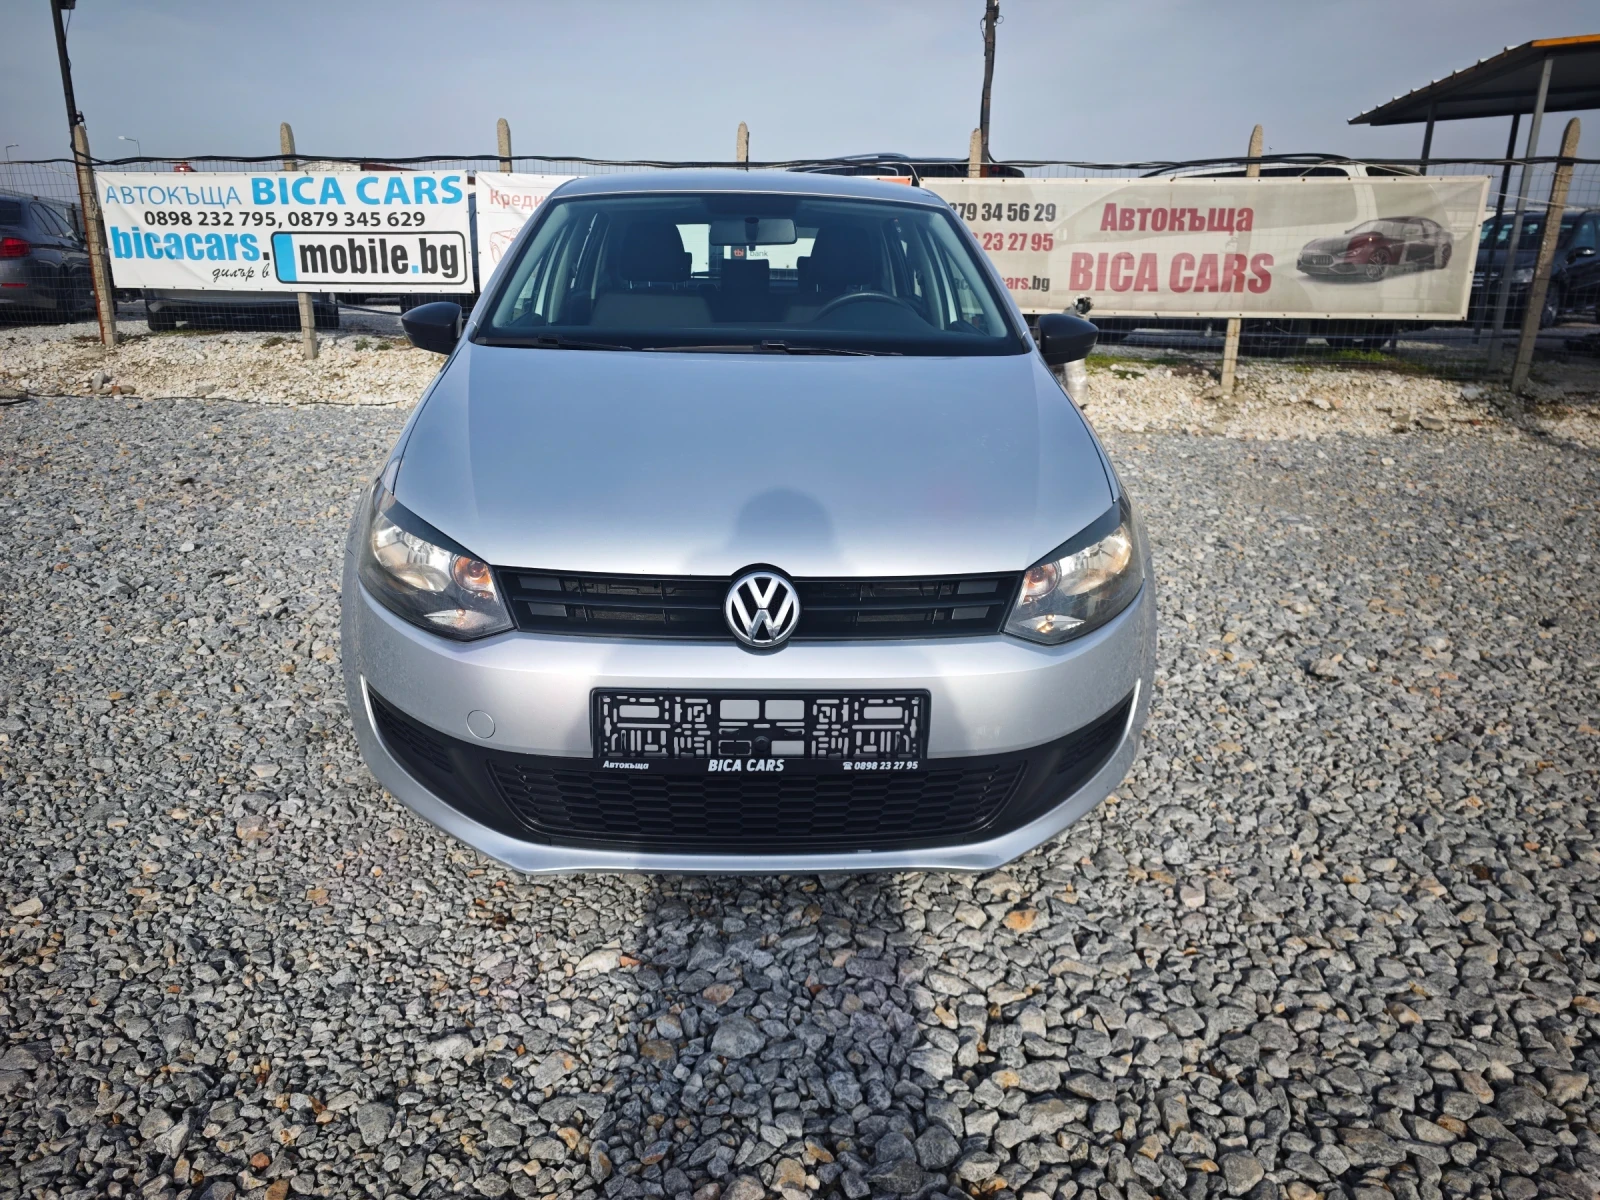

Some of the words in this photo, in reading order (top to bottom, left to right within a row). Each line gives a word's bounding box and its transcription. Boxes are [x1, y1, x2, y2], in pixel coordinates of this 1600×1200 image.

[105, 185, 242, 209] АВТОКЪЩА
[251, 176, 346, 206] BICA
[355, 175, 464, 206] CARS
[143, 211, 193, 226] 0898
[198, 211, 235, 227] 232
[239, 211, 283, 229] 795,
[287, 211, 339, 227] 0879
[344, 211, 381, 227] 345
[386, 211, 426, 227] 629
[981, 203, 1003, 222] 34
[1007, 203, 1031, 222] 56
[1033, 203, 1057, 222] 29
[1099, 202, 1255, 236] Автокъща
[109, 226, 271, 262] bicacars.
[982, 232, 1004, 251] 23
[1007, 232, 1028, 251] 27
[1030, 233, 1054, 252] 95
[299, 237, 459, 279] mobile.bg
[1068, 251, 1159, 293] BICA
[1168, 252, 1275, 294] CARS
[602, 760, 650, 770] Автокъща
[707, 759, 743, 772] BICA
[746, 759, 785, 772] CARS
[854, 761, 878, 770] 0898
[879, 761, 892, 770] 23
[893, 761, 906, 770] 27
[906, 761, 919, 770] 95
